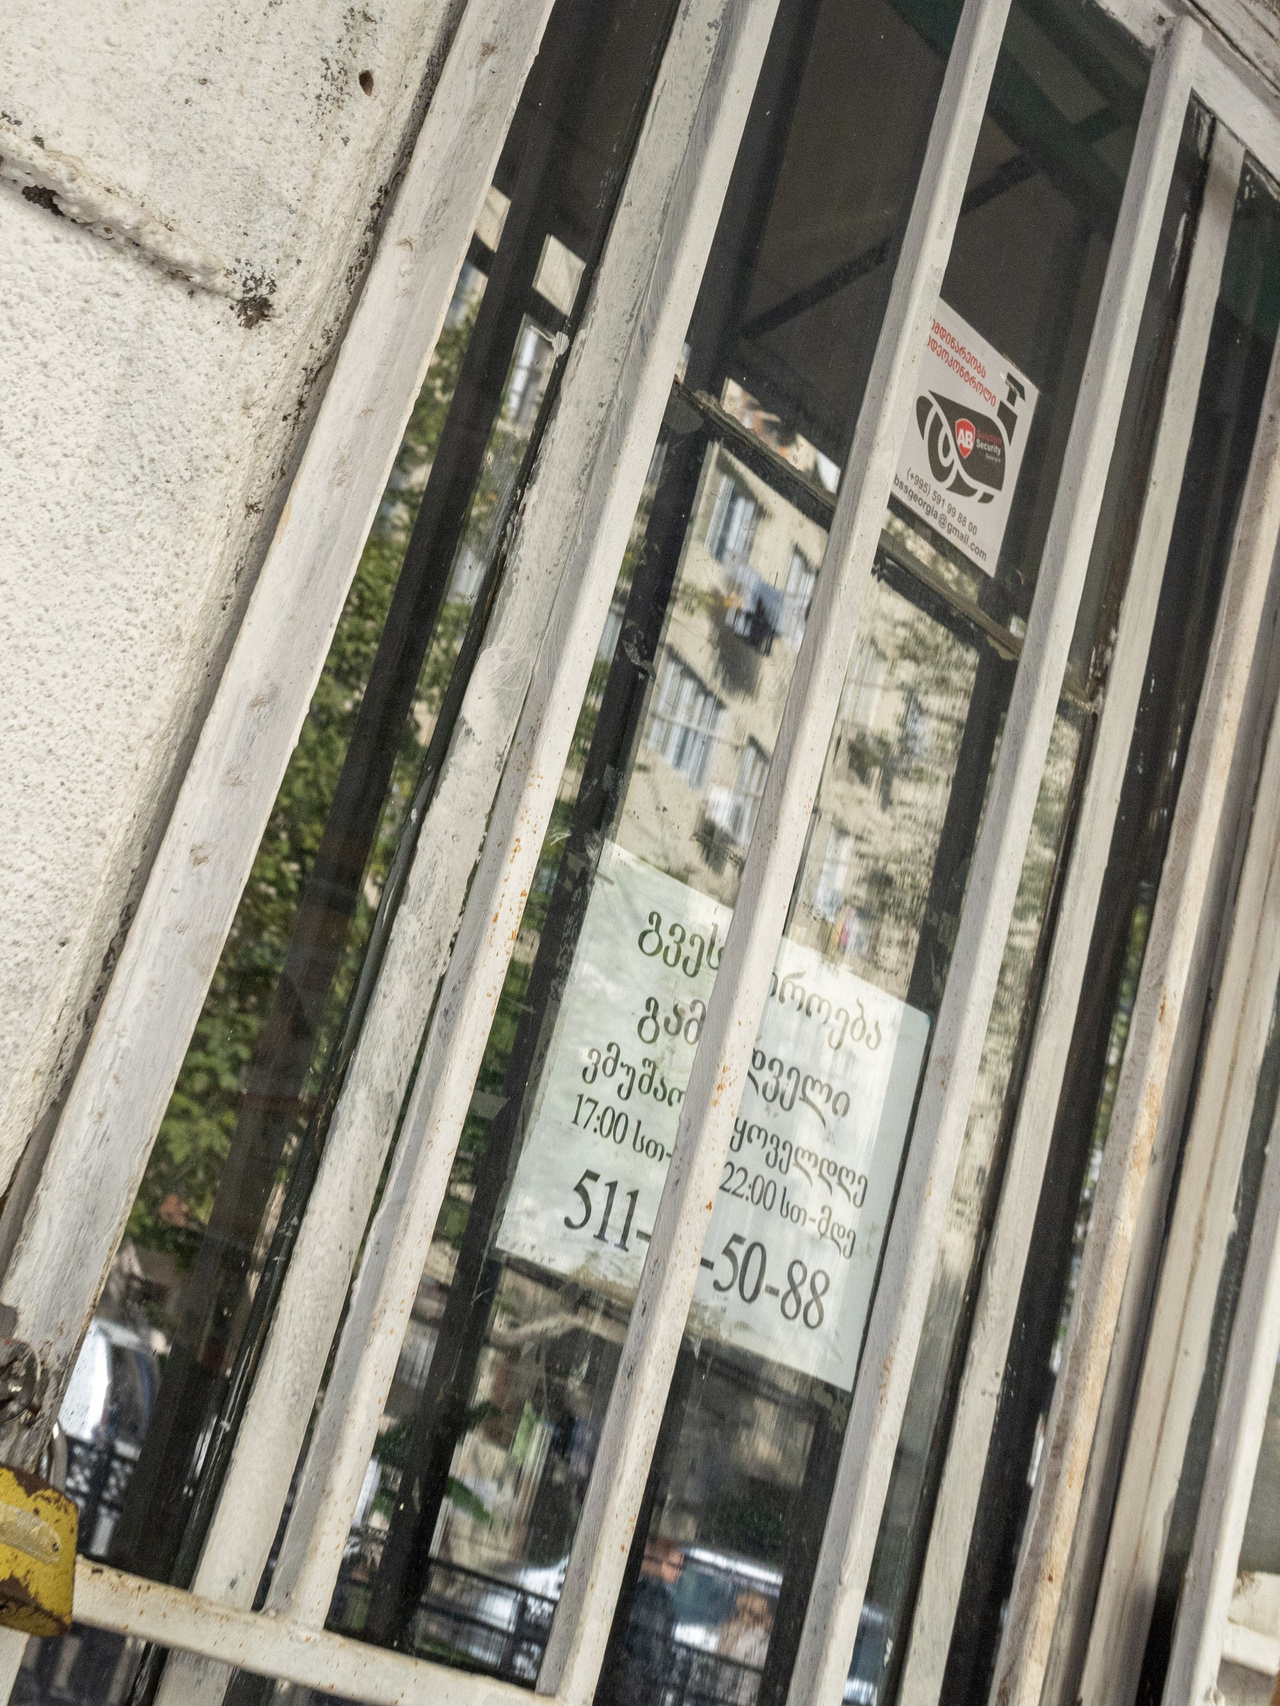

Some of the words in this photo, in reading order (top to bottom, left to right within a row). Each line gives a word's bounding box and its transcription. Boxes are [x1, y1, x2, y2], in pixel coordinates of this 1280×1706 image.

[927, 335, 997, 407] დეოკონტროლი
[931, 318, 986, 378] მდინარეობს
[957, 428, 974, 450] AB
[976, 438, 1001, 457] Security
[893, 473, 987, 561] bssgeorgia@gmail.com
[906, 467, 931, 497] (+995)
[932, 490, 946, 509] 591
[947, 503, 957, 518] 99
[957, 511, 967, 527] 88
[968, 521, 978, 536] 00
[571, 1093, 629, 1144] 17:00
[719, 1161, 777, 1212] 22:00
[779, 1186, 857, 1259] სთ-მდე
[729, 1116, 868, 1208] ყოველდღე
